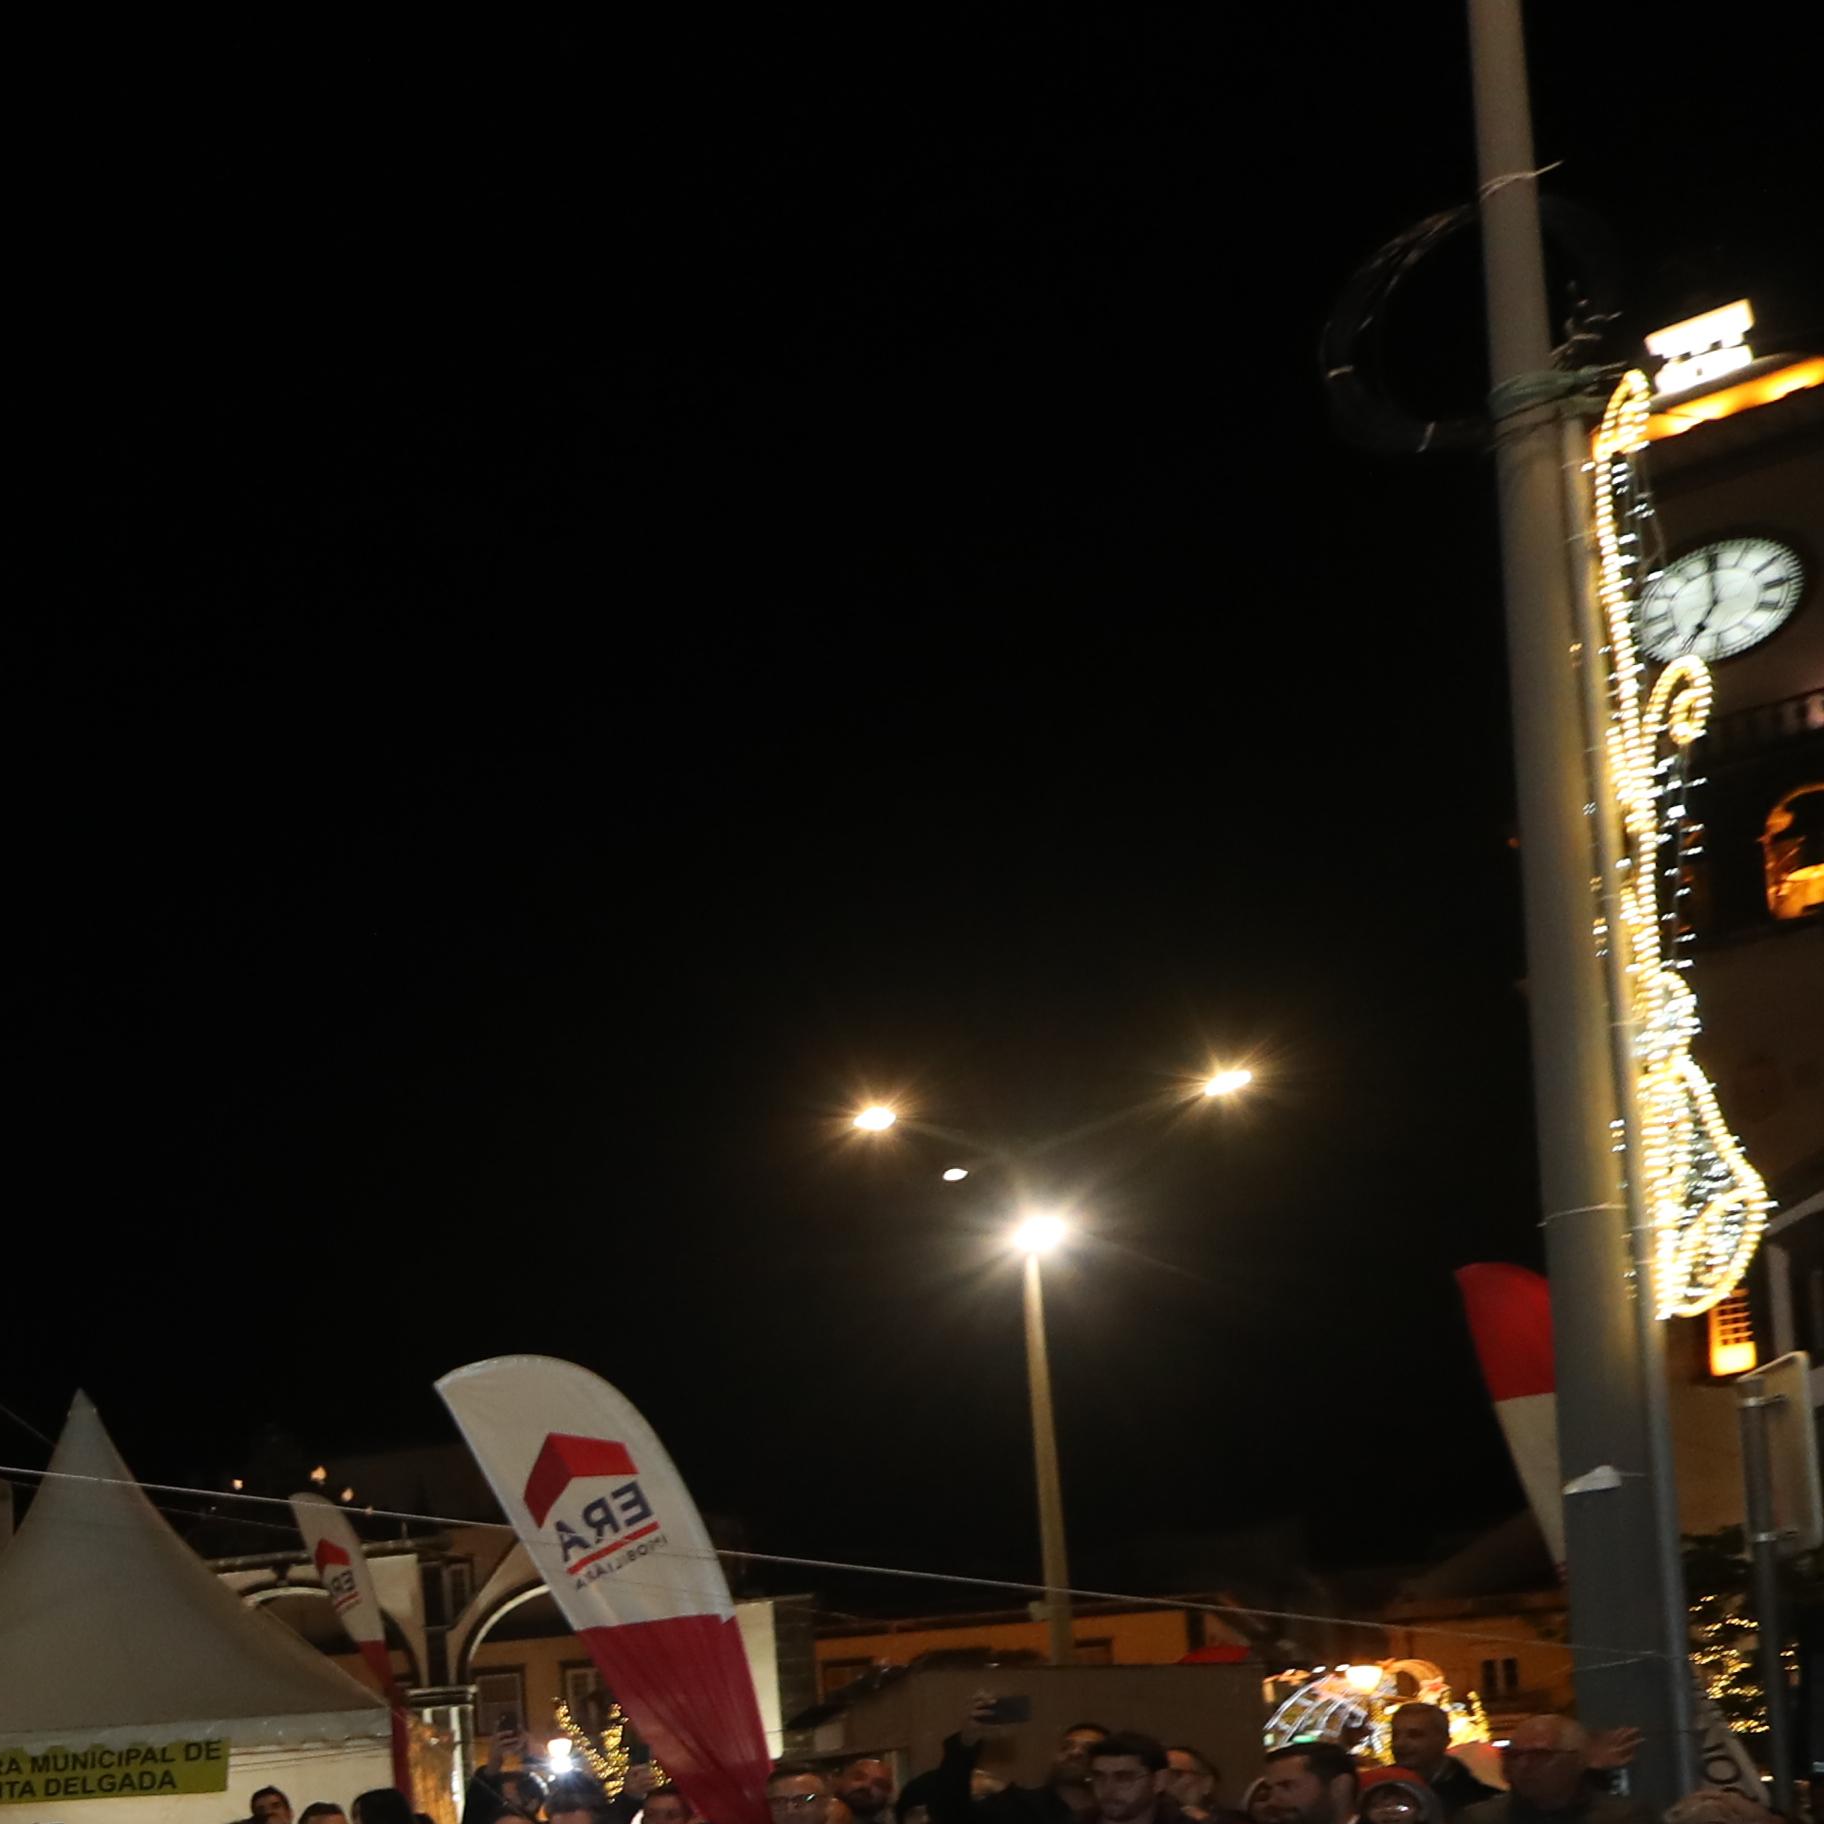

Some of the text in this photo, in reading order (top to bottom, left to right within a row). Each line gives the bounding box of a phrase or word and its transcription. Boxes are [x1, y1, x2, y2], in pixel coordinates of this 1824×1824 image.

[30, 1747, 177, 1774] MUNICIPAL
[184, 1740, 223, 1763] DE
[44, 1770, 178, 1797] DELGADA
